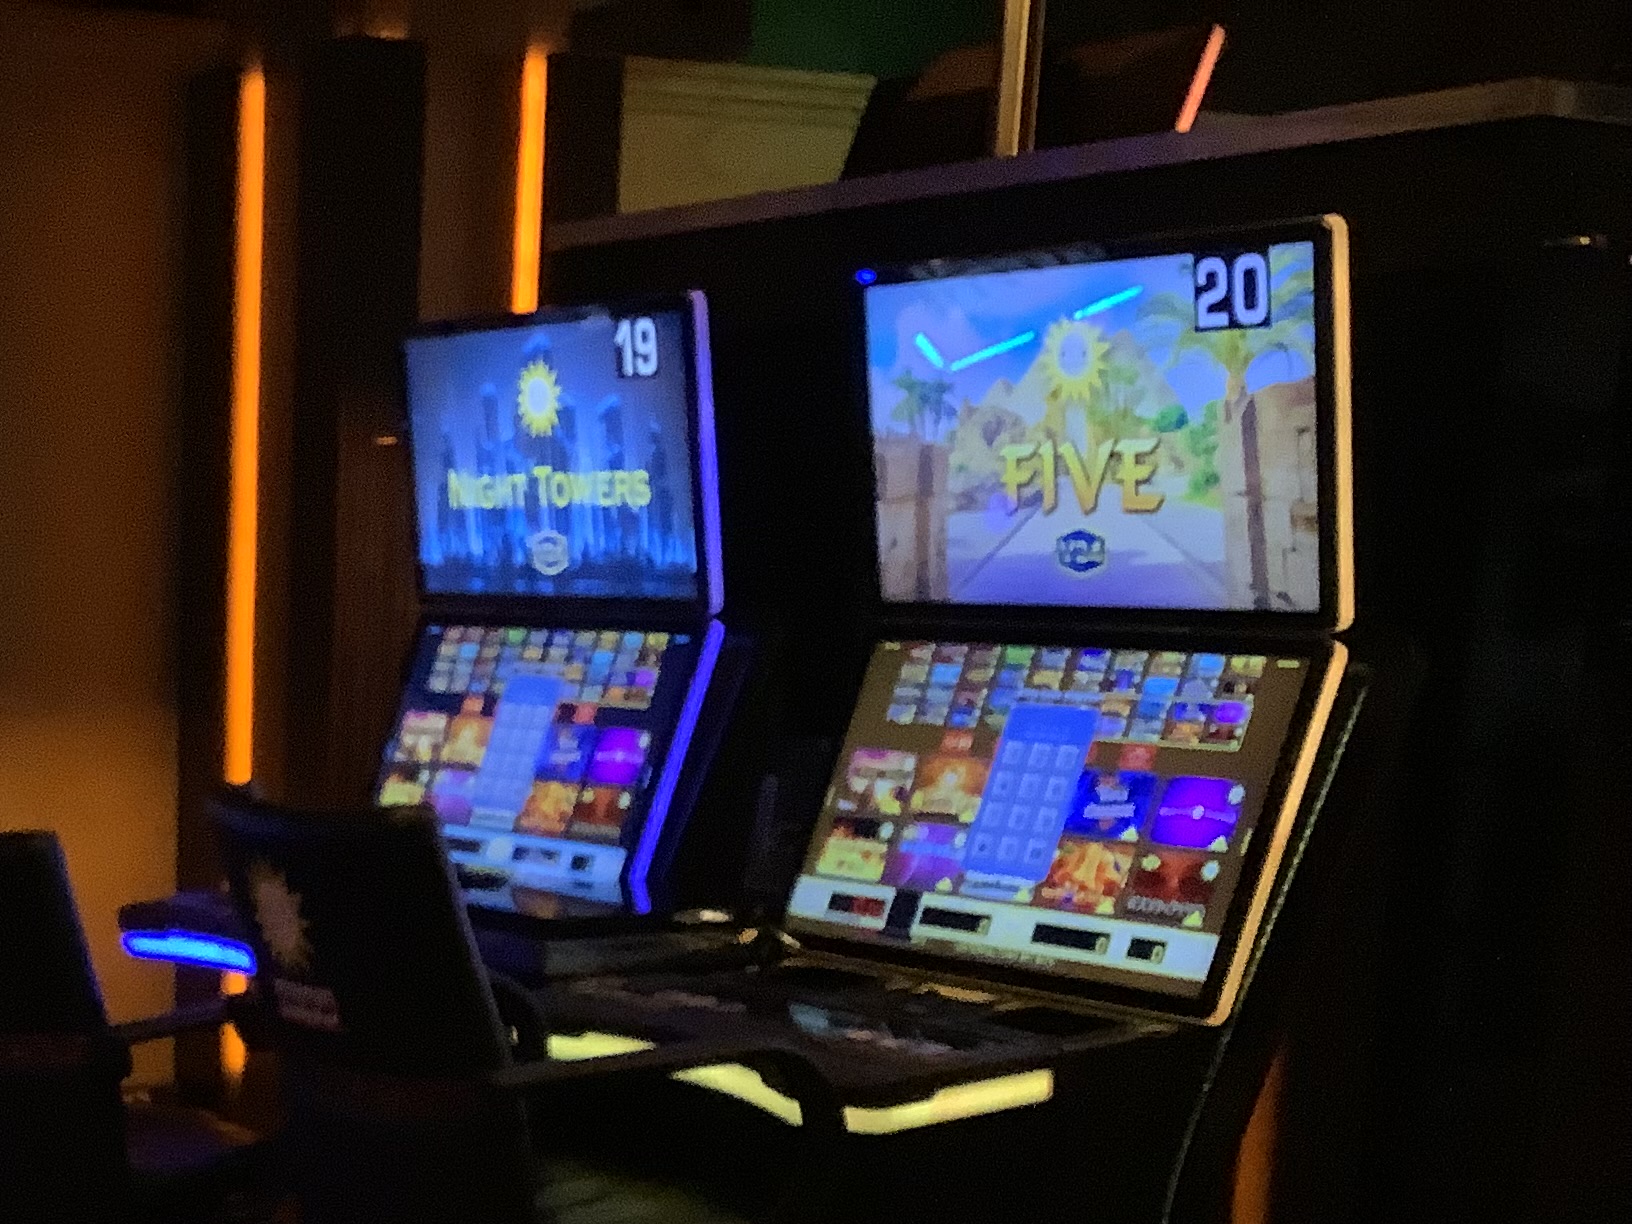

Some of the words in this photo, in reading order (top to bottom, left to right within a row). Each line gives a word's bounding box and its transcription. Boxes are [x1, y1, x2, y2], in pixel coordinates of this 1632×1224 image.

[1194, 252, 1270, 329] 20
[614, 316, 659, 377] 19
[999, 436, 1166, 517] FIVE
